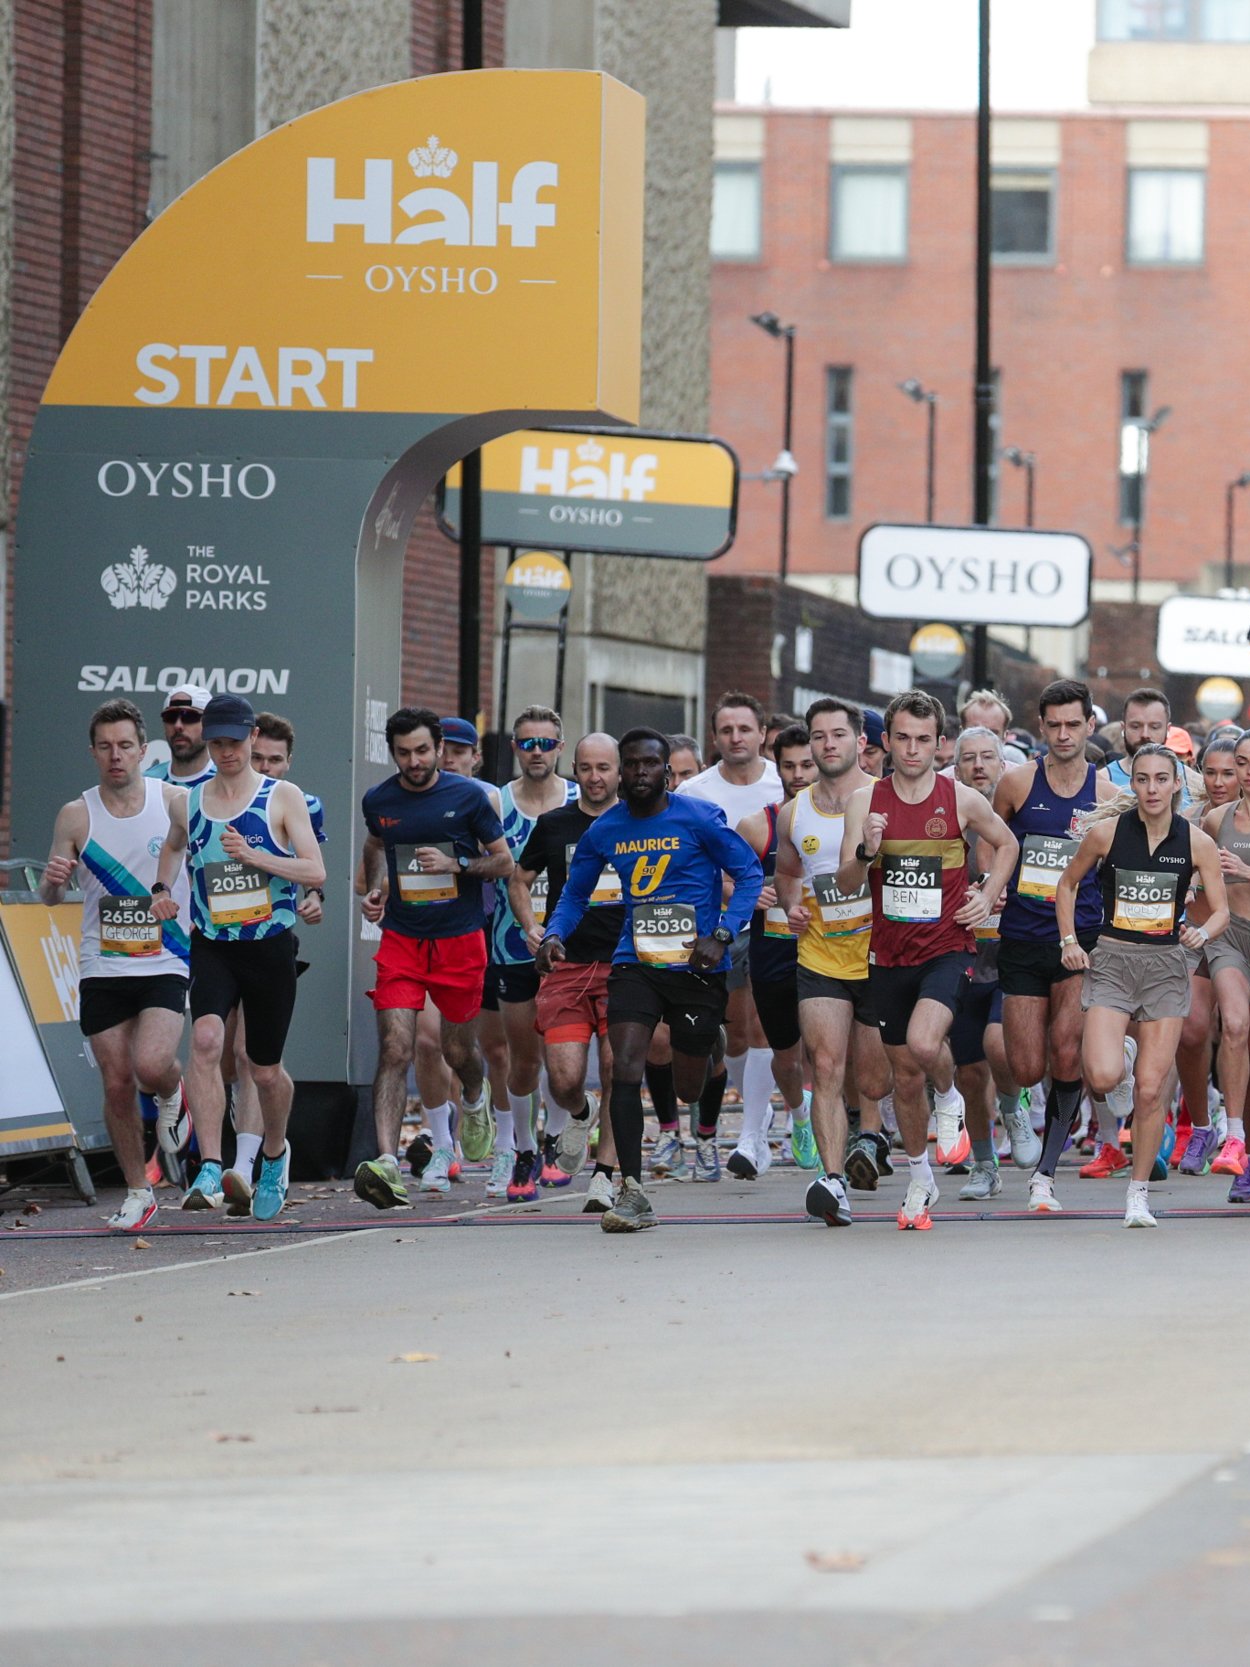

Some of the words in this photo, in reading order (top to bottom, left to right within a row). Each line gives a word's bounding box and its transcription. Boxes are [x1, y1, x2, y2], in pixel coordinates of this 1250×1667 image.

[306, 158, 558, 246] Half
[364, 264, 498, 294] OYSHO
[133, 343, 373, 408] START
[98, 460, 276, 500] OYSHO
[520, 446, 658, 502] Half
[549, 505, 622, 526] OYSHO
[187, 546, 215, 558] THE
[186, 564, 270, 585] ROYAL
[886, 553, 1062, 597] OYSHO
[186, 591, 267, 611] PARKS
[78, 665, 290, 695] SALOMON
[615, 837, 680, 855] MAURICE
[1159, 856, 1186, 865] OYSHO
[642, 866, 657, 875] 90
[886, 870, 935, 886] 22061
[212, 874, 260, 892] 20511
[892, 889, 918, 903] BEN
[1118, 885, 1172, 901] 23605
[102, 909, 157, 923] 26505
[835, 907, 854, 918] SAM
[105, 925, 155, 940] GEORGE
[636, 917, 693, 933] 25030
